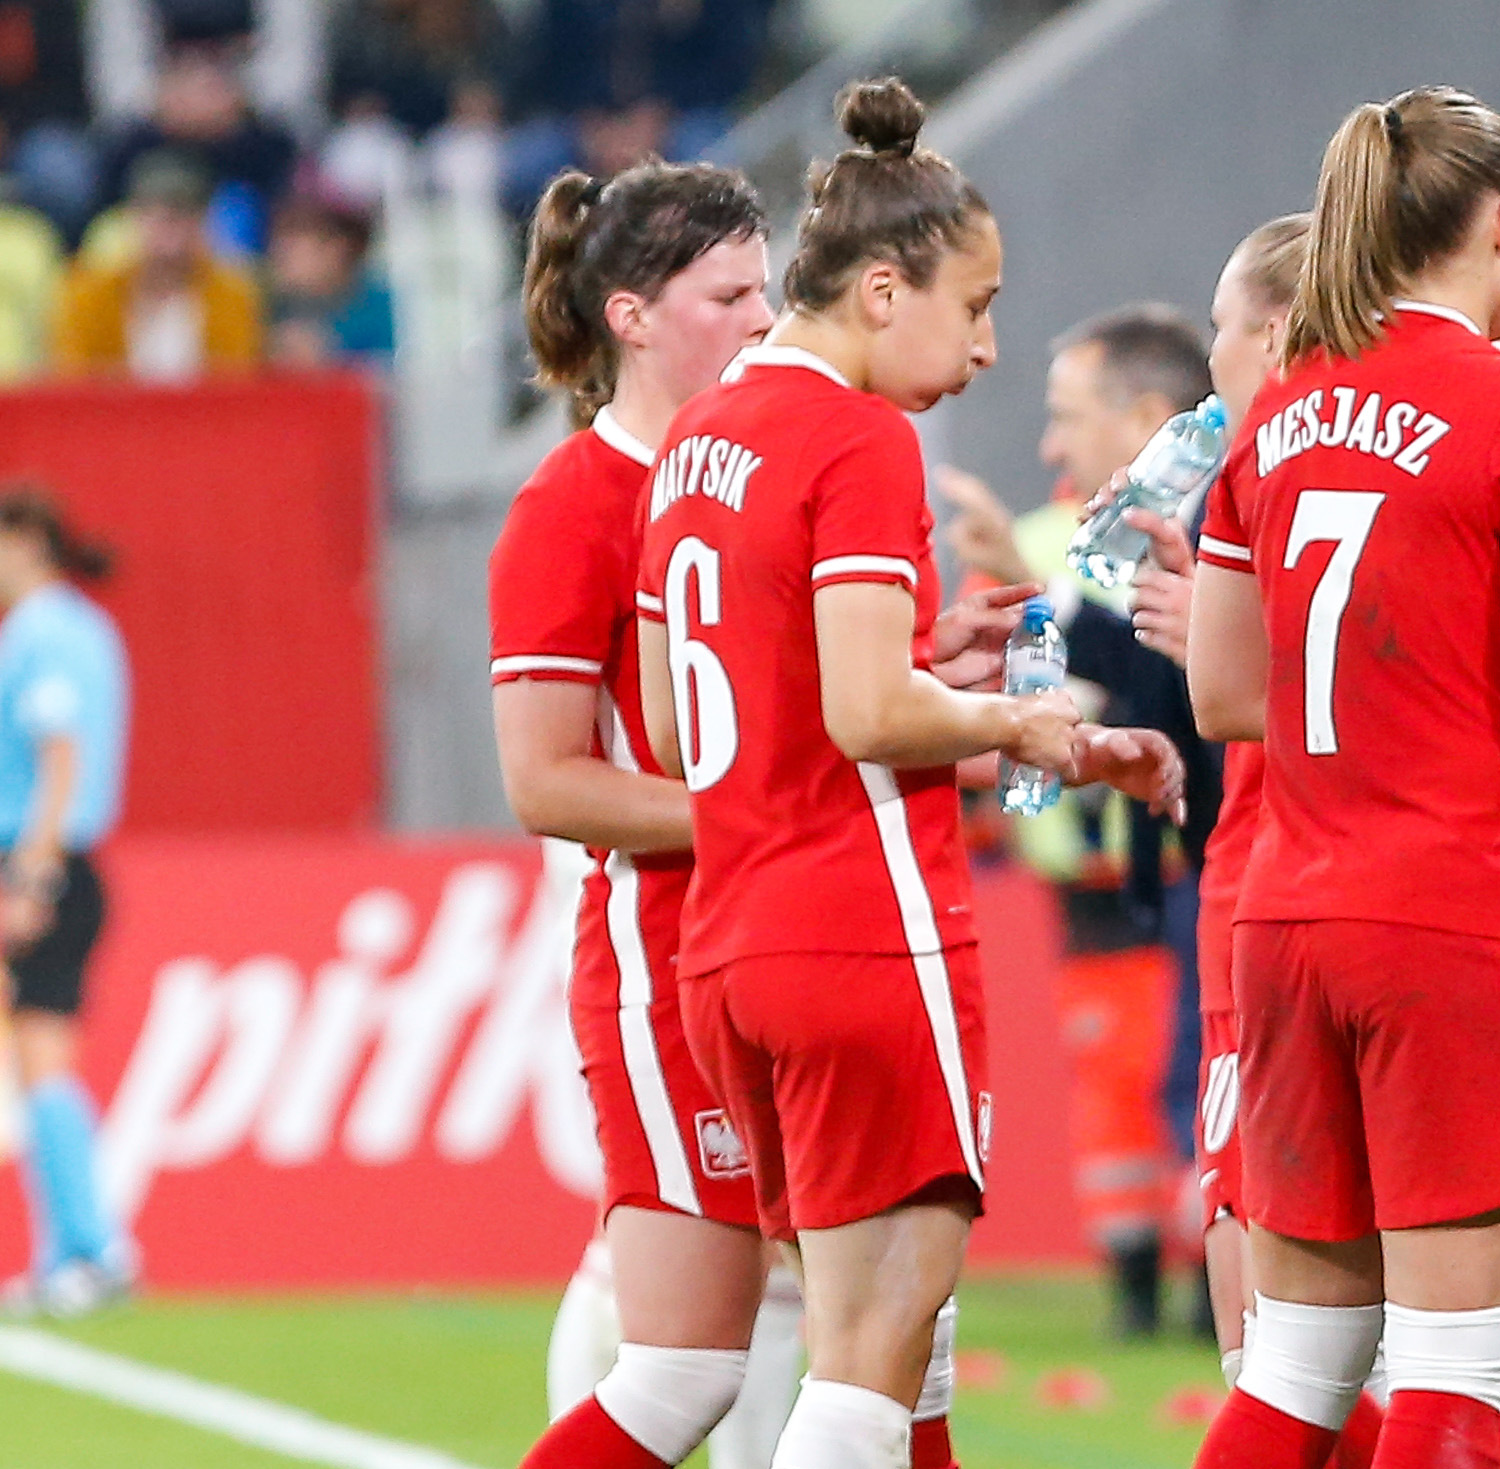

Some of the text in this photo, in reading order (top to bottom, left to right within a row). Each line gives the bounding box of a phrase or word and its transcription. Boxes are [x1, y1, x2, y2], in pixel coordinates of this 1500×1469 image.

[649, 434, 764, 524] MATYSIK
[1256, 386, 1452, 478] MESJASZ
[664, 535, 740, 793] 6
[1283, 489, 1387, 756] 7
